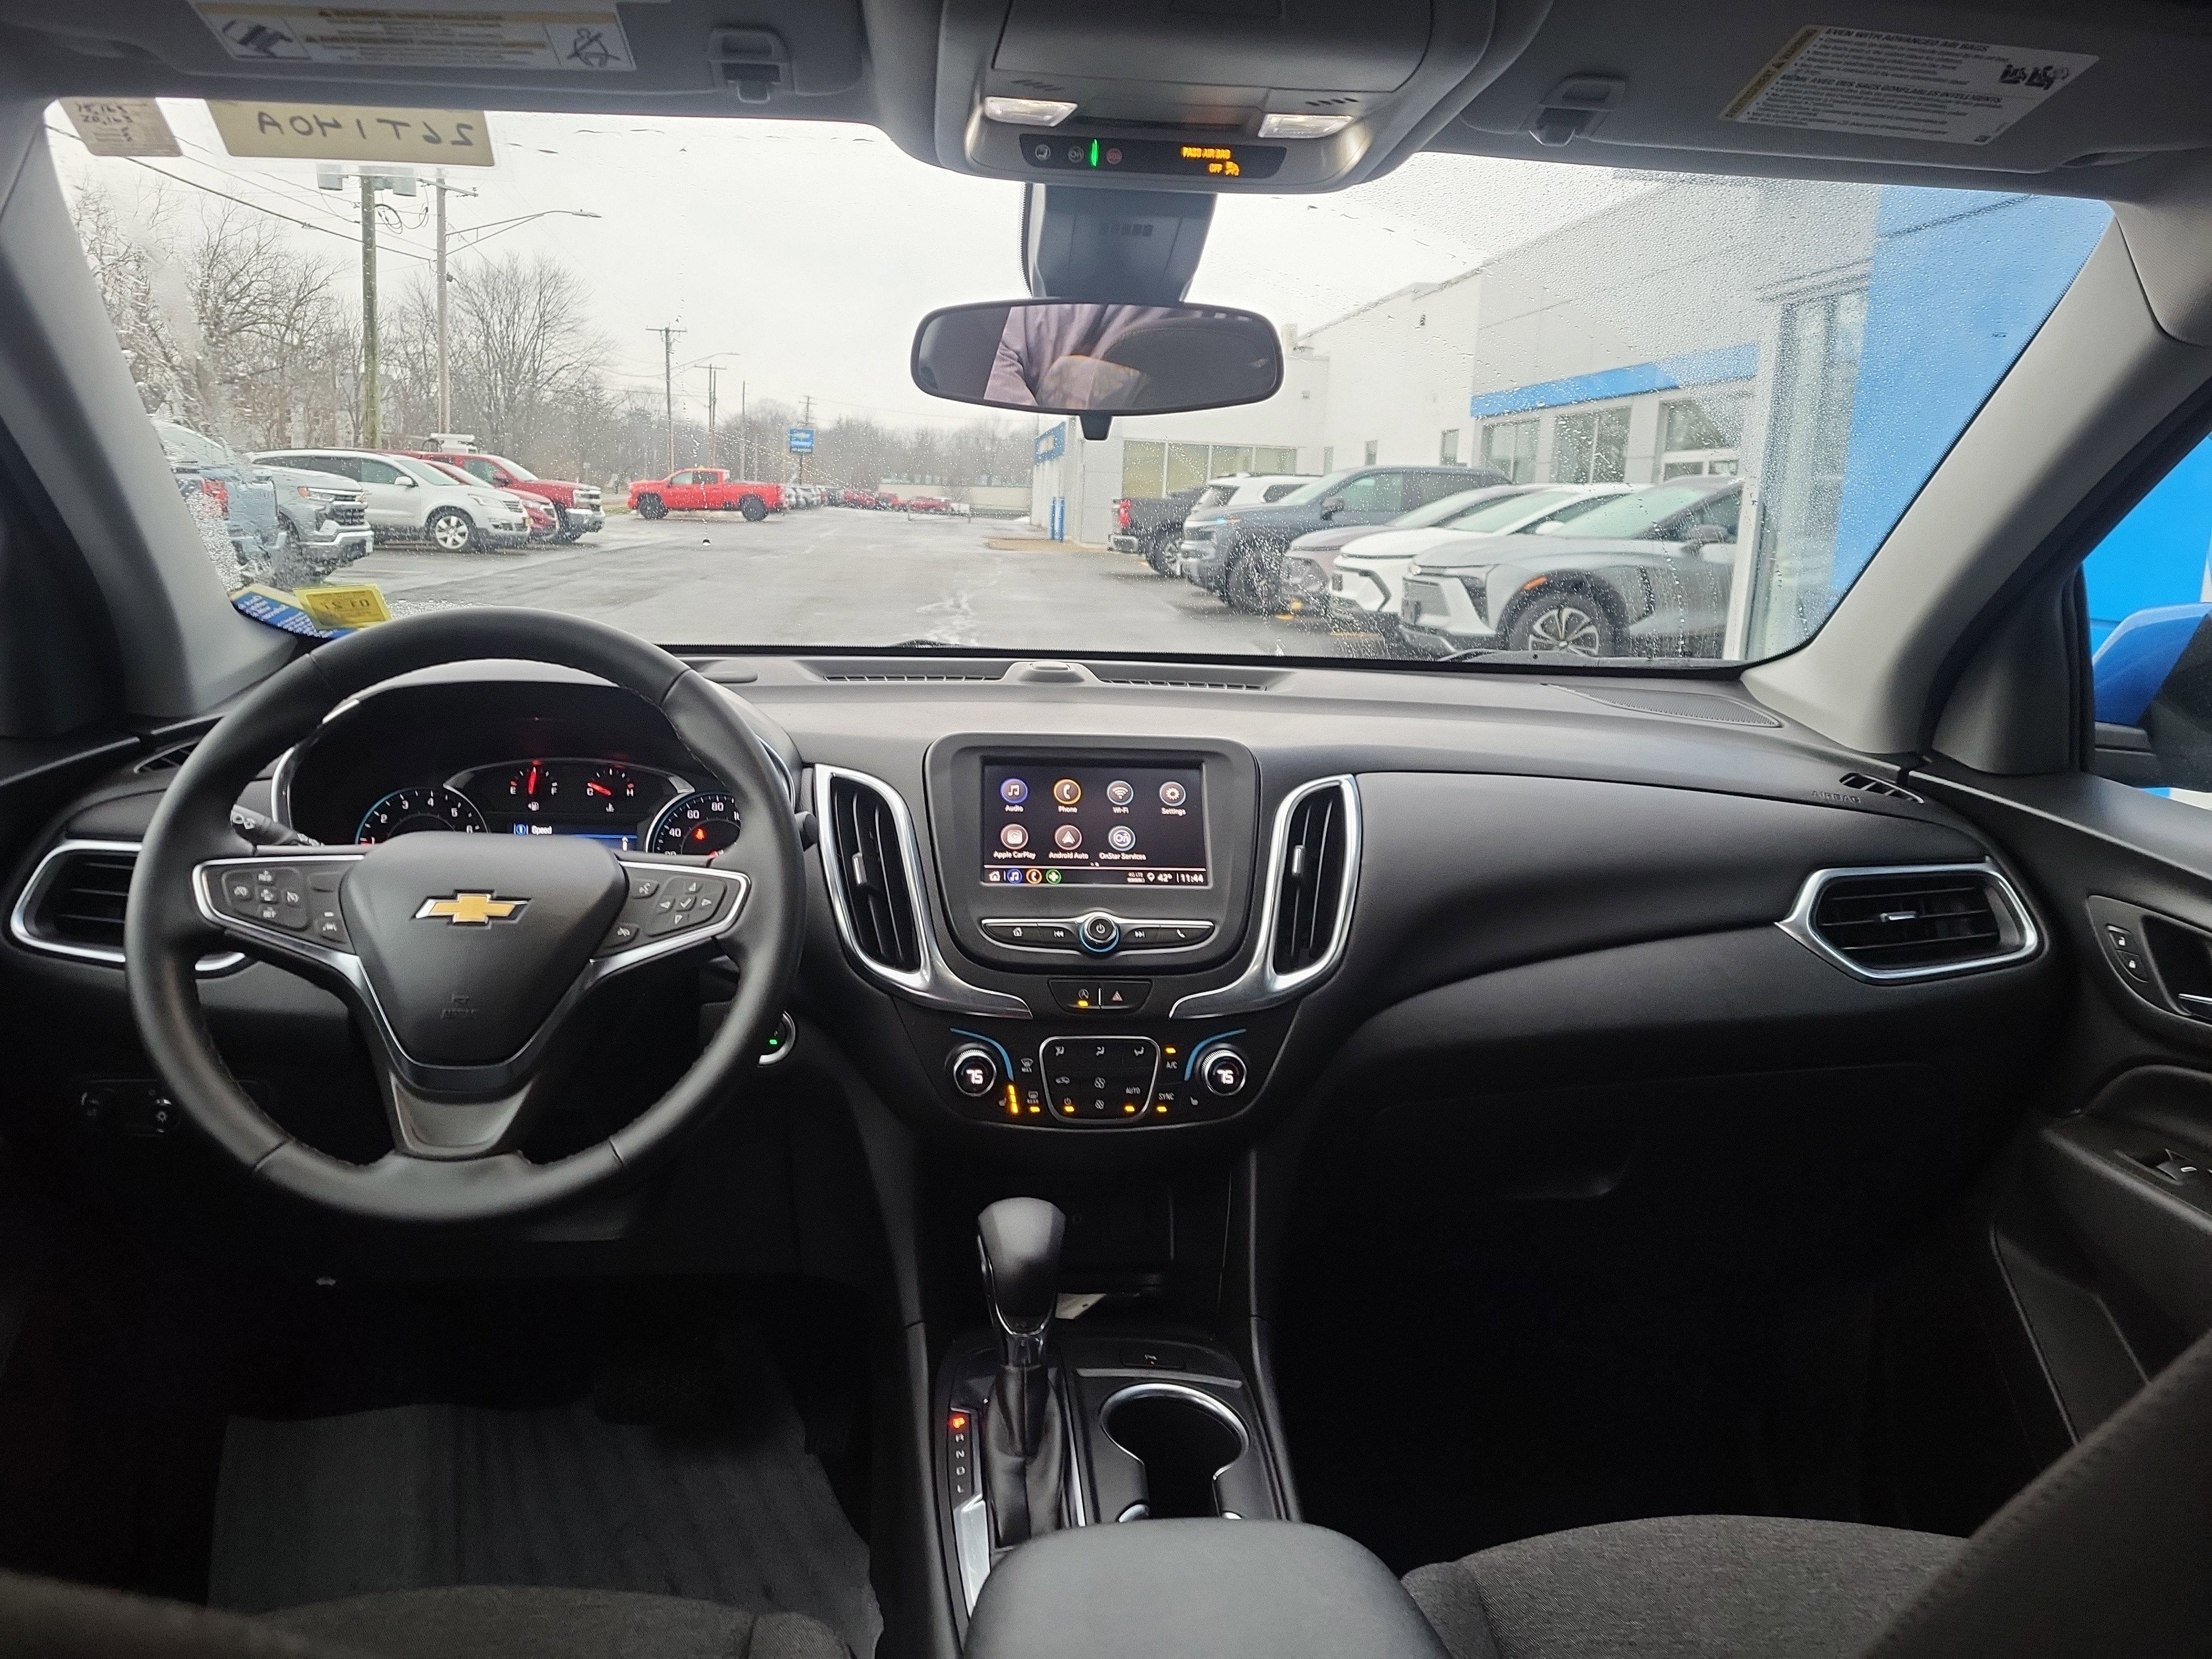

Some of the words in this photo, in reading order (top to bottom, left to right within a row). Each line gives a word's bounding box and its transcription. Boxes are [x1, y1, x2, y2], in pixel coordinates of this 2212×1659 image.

[551, 787, 557, 795] F
[401, 800, 409, 810] 3
[427, 797, 434, 807] 4
[712, 802, 724, 812] 80
[1058, 805, 1078, 813] Phone
[1161, 807, 1186, 816] Settings
[687, 810, 700, 819] 60
[531, 825, 552, 834] Speed
[669, 827, 681, 837] 40
[993, 851, 1012, 859] Apple
[1013, 851, 1036, 860] CarPlay
[1099, 852, 1121, 860] OnStar
[1121, 852, 1146, 860] Services
[1180, 873, 1204, 883] 11:44
[966, 1069, 983, 1084] 75
[1217, 1069, 1234, 1084] 75
[1159, 1092, 1175, 1100] SYNC
